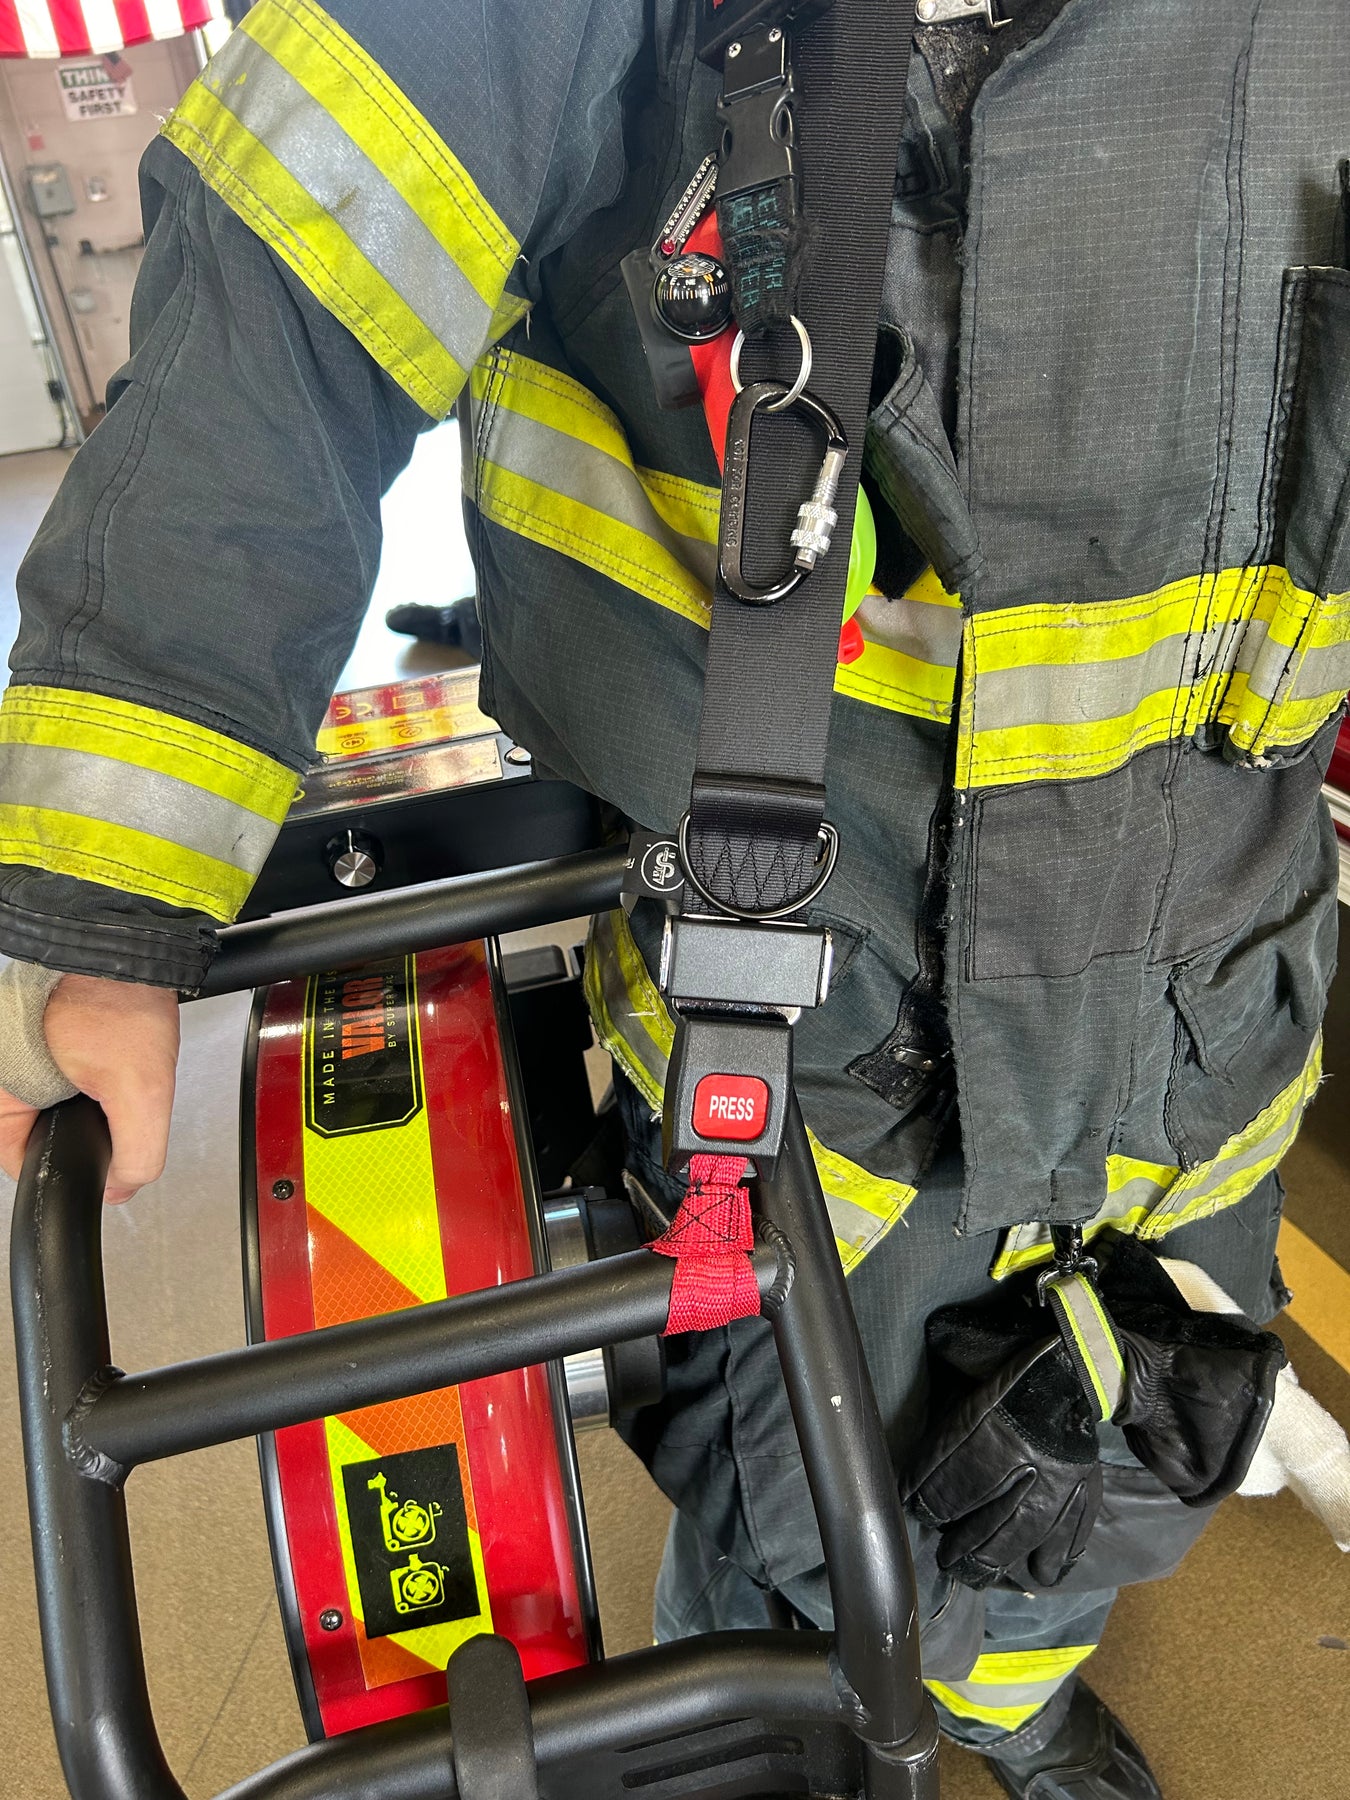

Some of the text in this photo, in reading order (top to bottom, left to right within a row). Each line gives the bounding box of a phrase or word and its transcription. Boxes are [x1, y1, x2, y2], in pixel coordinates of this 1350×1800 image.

[62, 67, 110, 86] THIN
[68, 87, 126, 103] SAFETY
[79, 101, 121, 117] FIRST
[703, 273, 714, 283] N
[733, 438, 745, 461] NOT
[731, 467, 743, 490] FOR
[323, 989, 336, 1013] THE
[341, 976, 386, 1060] VALOR
[322, 1022, 335, 1039] IN
[388, 1033, 397, 1048] BY
[322, 1050, 335, 1105] MADE
[709, 1095, 755, 1121] PRESS
